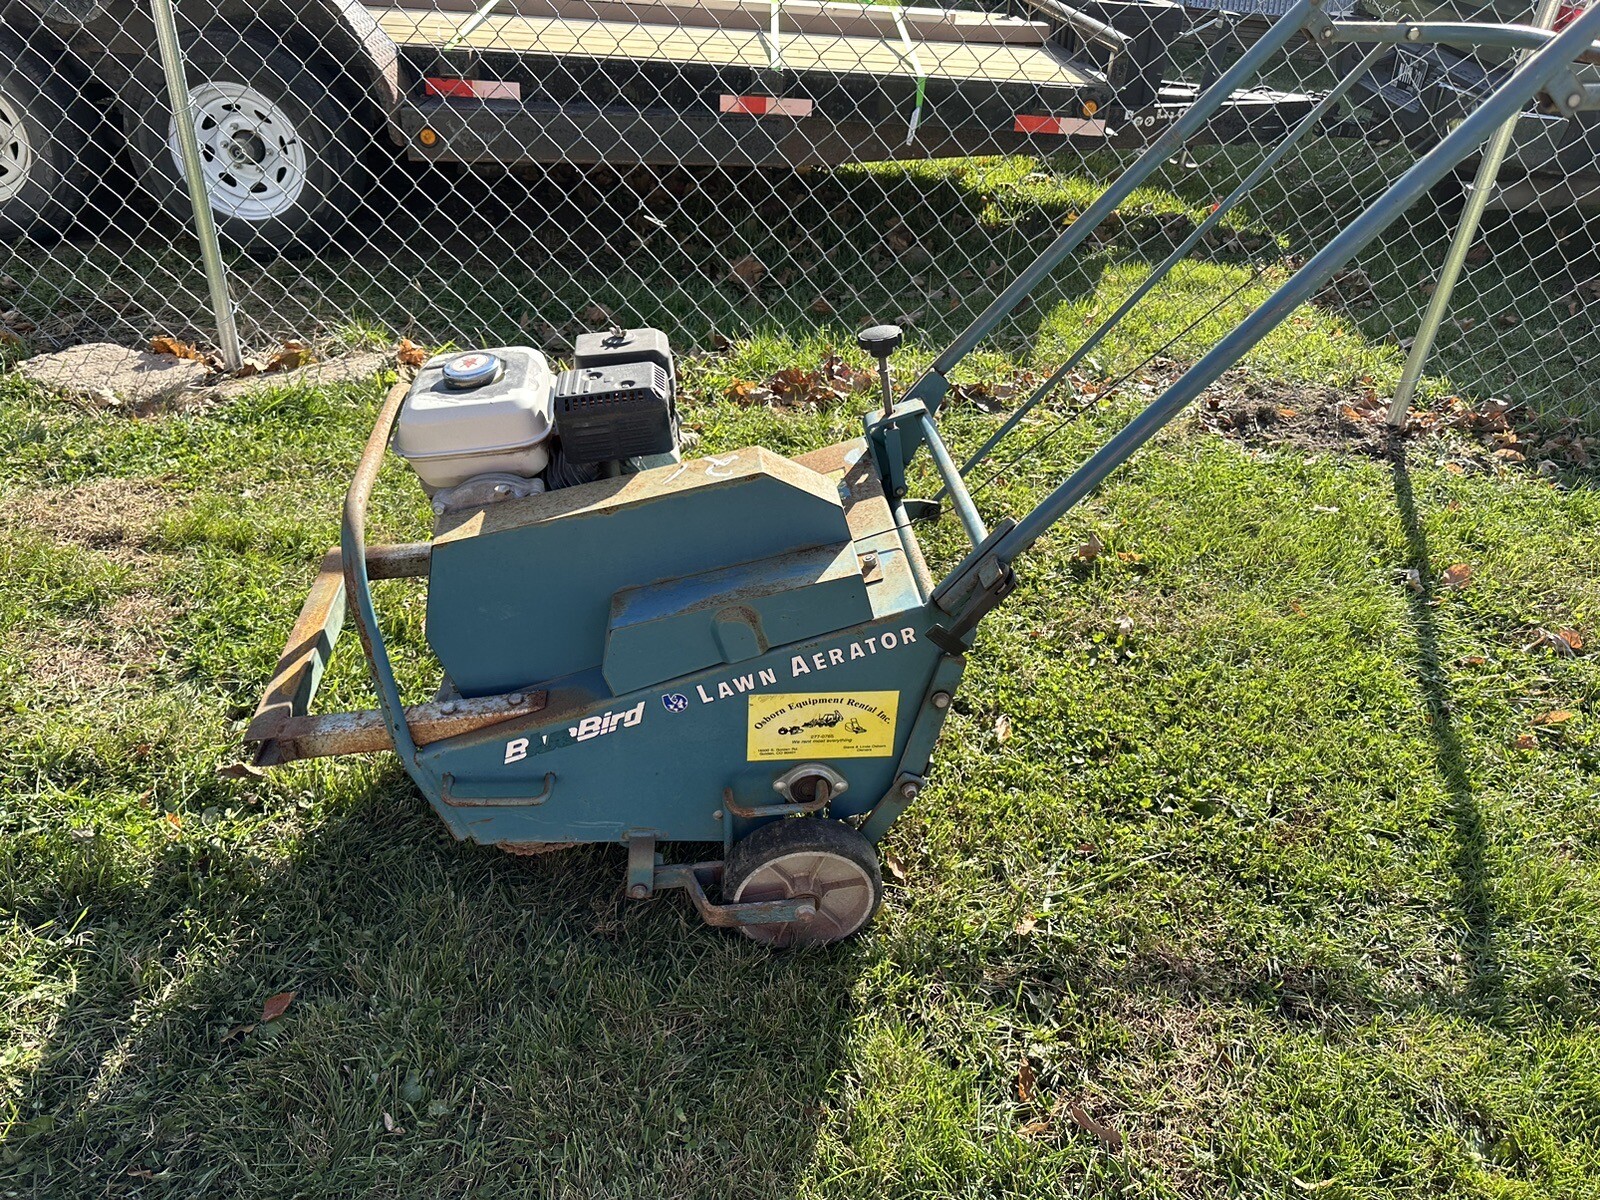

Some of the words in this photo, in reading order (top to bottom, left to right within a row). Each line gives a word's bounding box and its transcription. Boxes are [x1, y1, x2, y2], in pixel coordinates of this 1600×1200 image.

[695, 667, 778, 704] LAWN
[790, 626, 918, 678] AERATOR
[504, 700, 646, 765] BBird
[754, 708, 786, 730] Osborn
[788, 697, 844, 711] Equipment
[846, 698, 878, 714] Rental
[876, 710, 891, 725] Inc.
